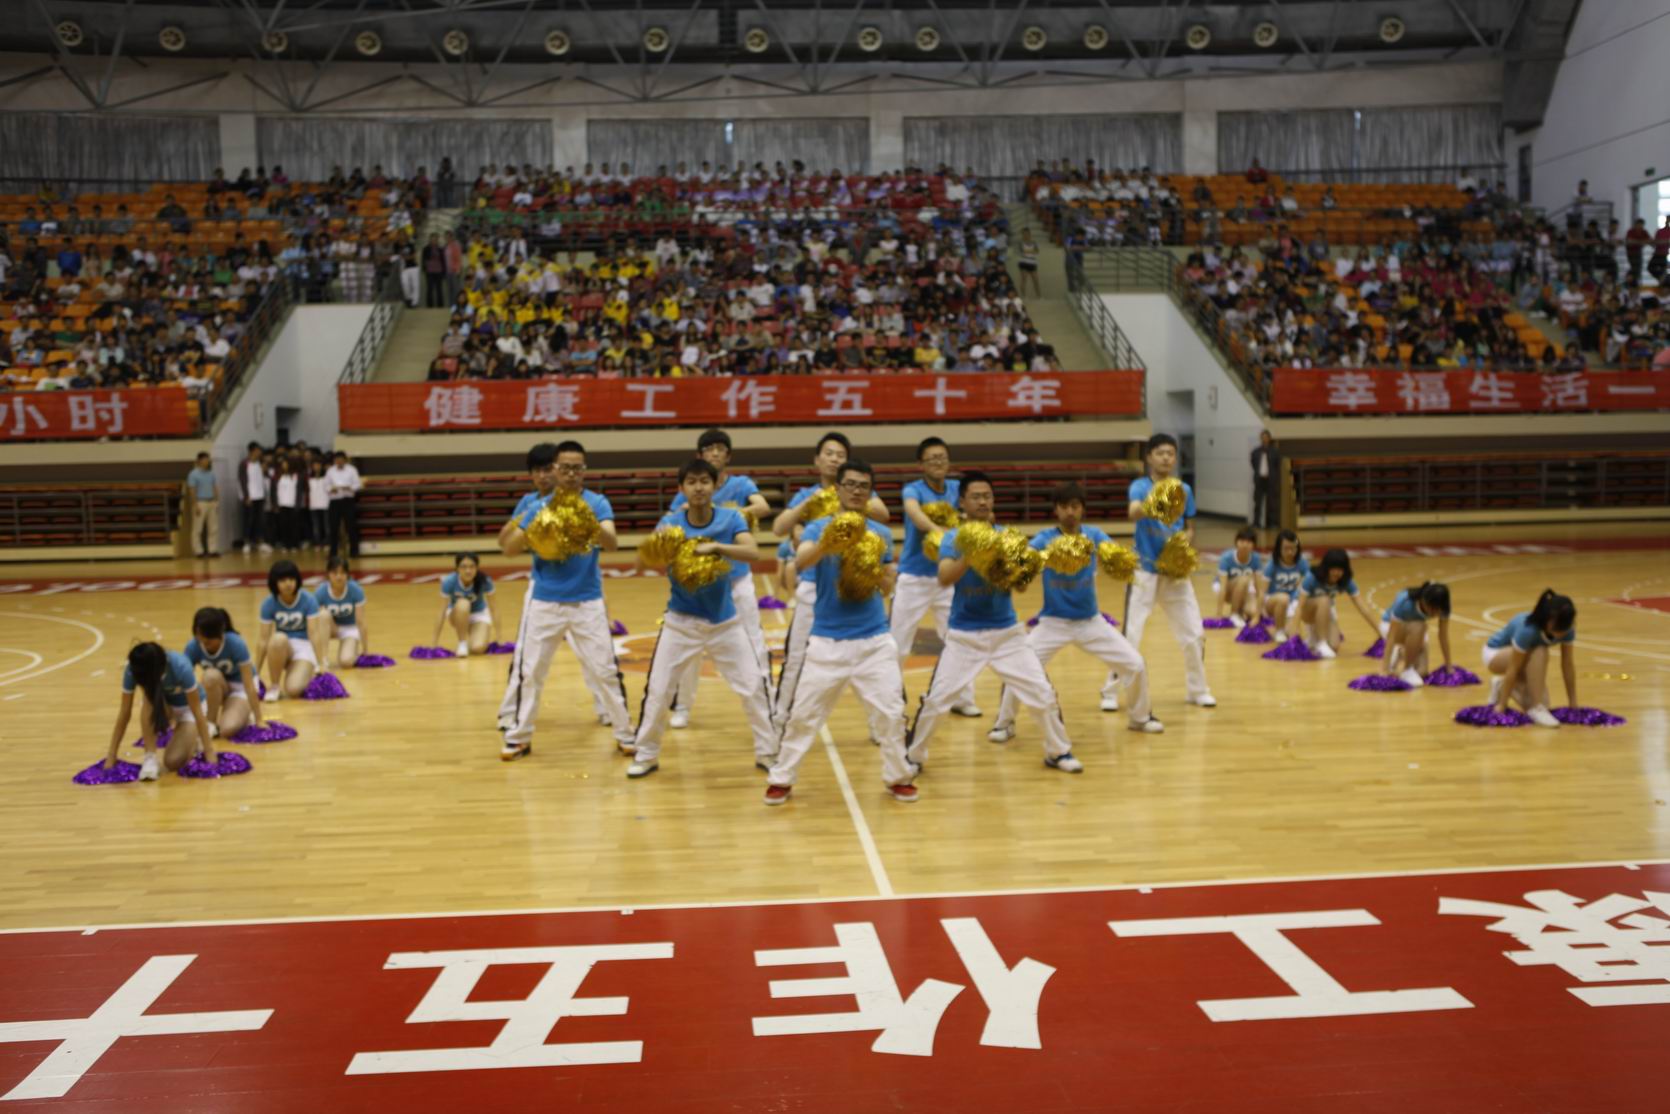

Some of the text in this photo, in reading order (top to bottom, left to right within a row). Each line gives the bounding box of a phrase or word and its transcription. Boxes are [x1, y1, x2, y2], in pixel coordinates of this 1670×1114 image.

[424, 375, 1063, 428] 健康工作五十年
[1327, 371, 1656, 412] 幸福生活一
[0, 392, 128, 437] 小时
[275, 611, 304, 631] 22
